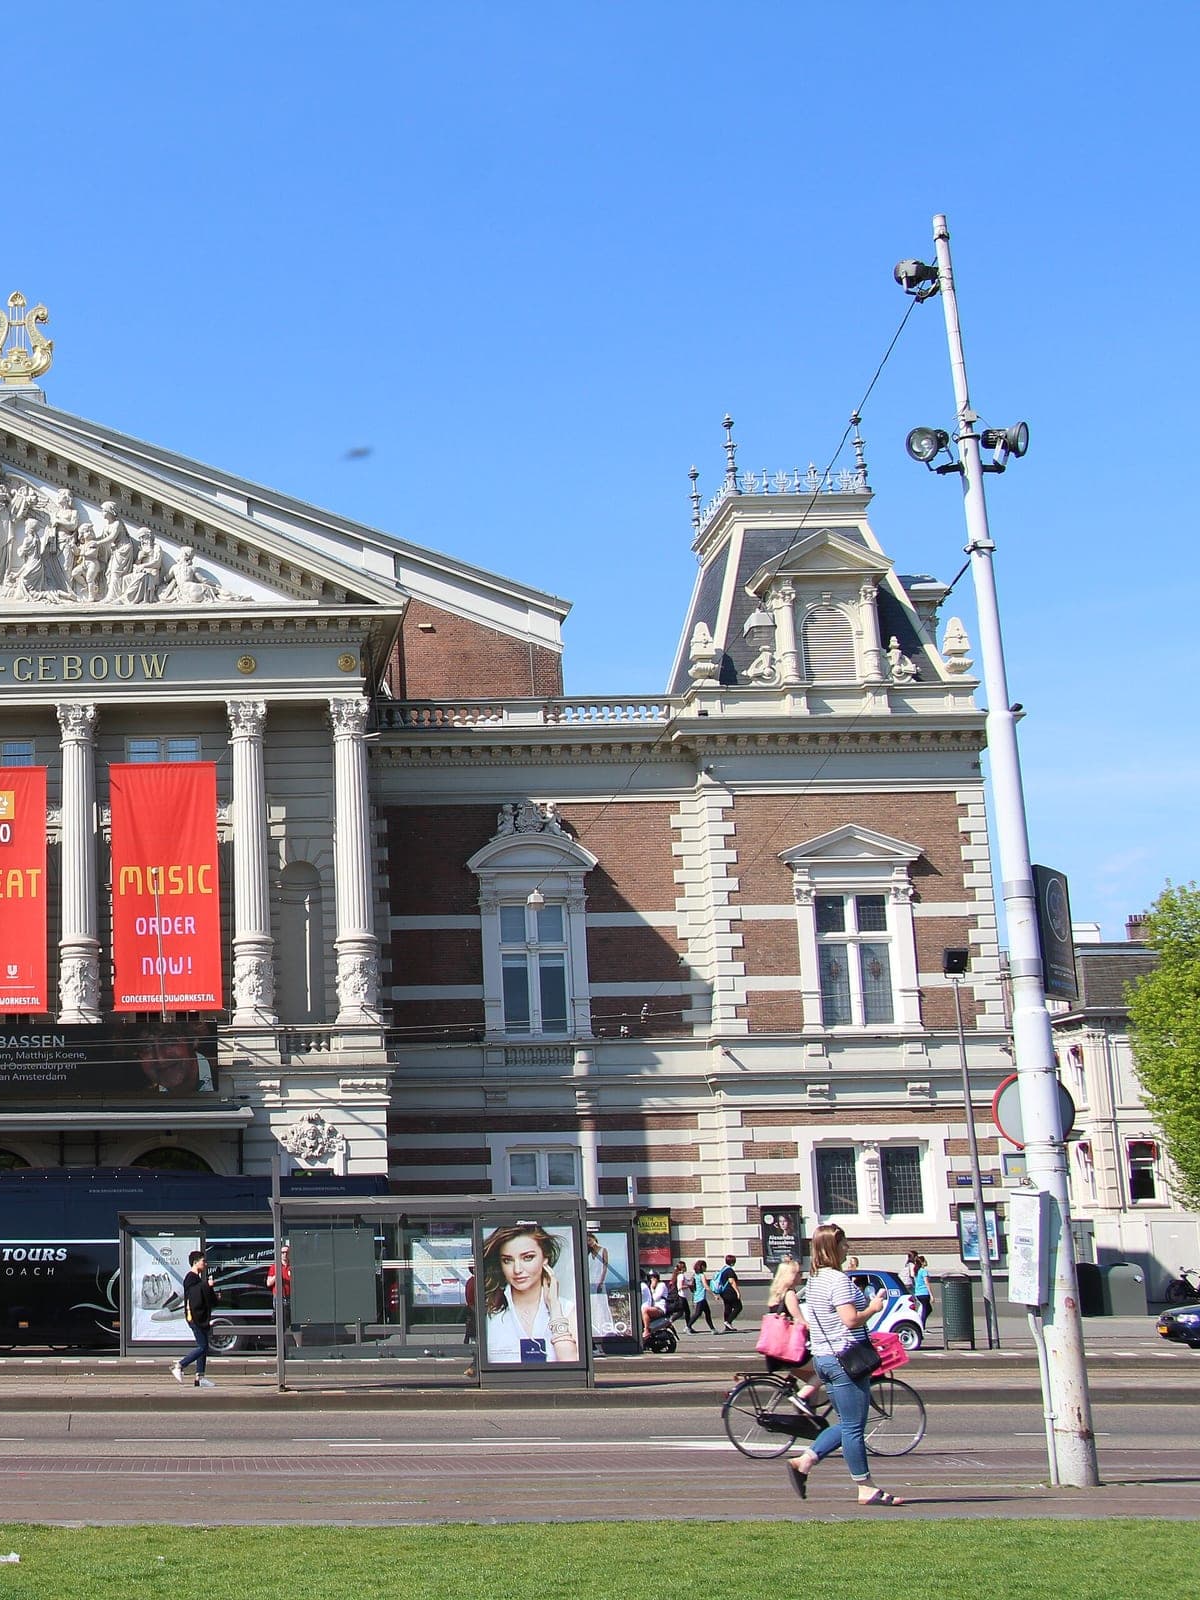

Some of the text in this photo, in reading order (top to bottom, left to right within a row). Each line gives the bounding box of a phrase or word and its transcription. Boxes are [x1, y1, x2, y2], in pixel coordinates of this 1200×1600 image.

[119, 864, 213, 895] MUSIC
[135, 916, 196, 935] ORDER
[142, 956, 192, 975] NOW!
[16, 1051, 54, 1060] Matthijs
[55, 1051, 87, 1060] Koene,
[12, 1072, 67, 1081] Amsterdam
[2, 1248, 68, 1261] TOURS
